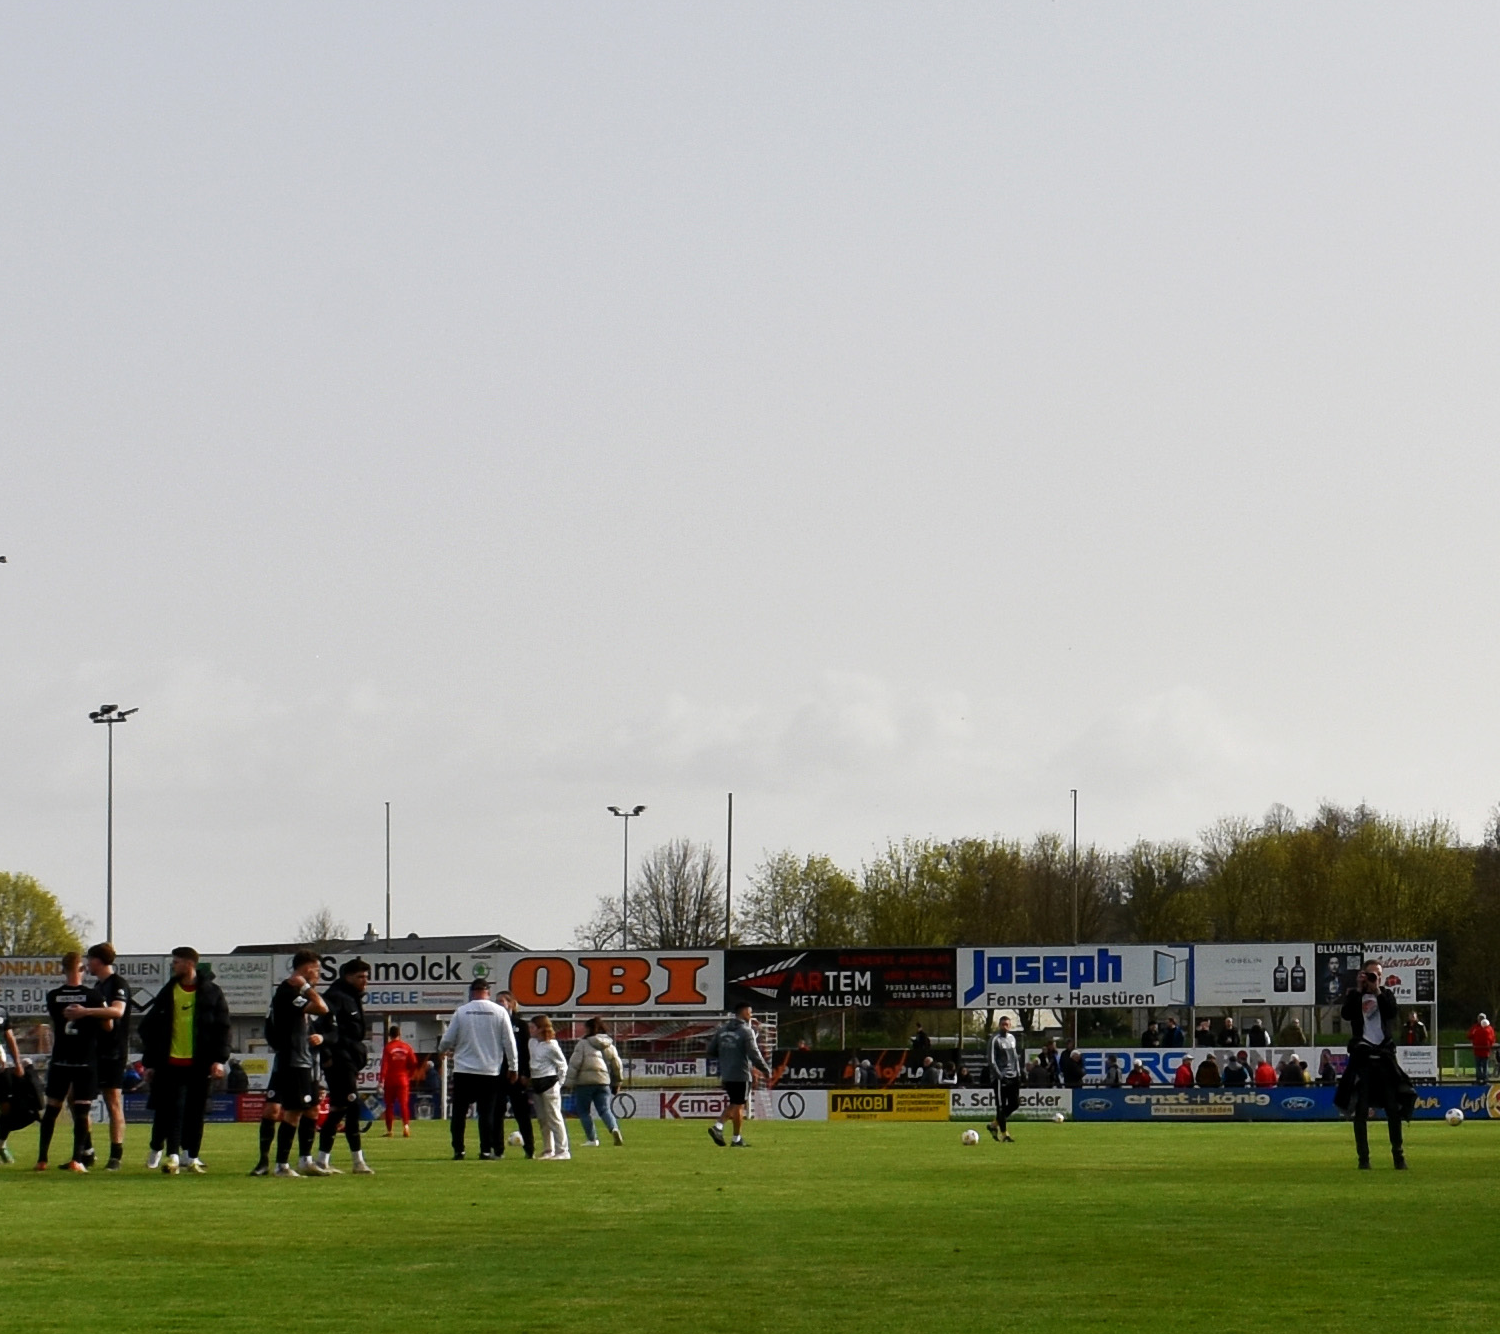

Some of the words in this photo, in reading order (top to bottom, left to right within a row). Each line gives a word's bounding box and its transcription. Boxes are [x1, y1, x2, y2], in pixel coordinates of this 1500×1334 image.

[219, 962, 268, 973] GALABAU
[509, 956, 709, 1006] OBI
[791, 970, 871, 992] ARTEM
[964, 948, 1122, 1005] Joseph
[790, 995, 871, 1006] METALLBAU
[986, 992, 1050, 1005] Fenster
[1054, 994, 1063, 1003] +
[1069, 990, 1155, 1005] Haustüren
[645, 1063, 697, 1076] KINDLER
[837, 1096, 888, 1110] JAKOBI
[952, 1094, 965, 1106] R.
[1125, 1093, 1189, 1104] ernst
[1208, 1092, 1271, 1106] könig
